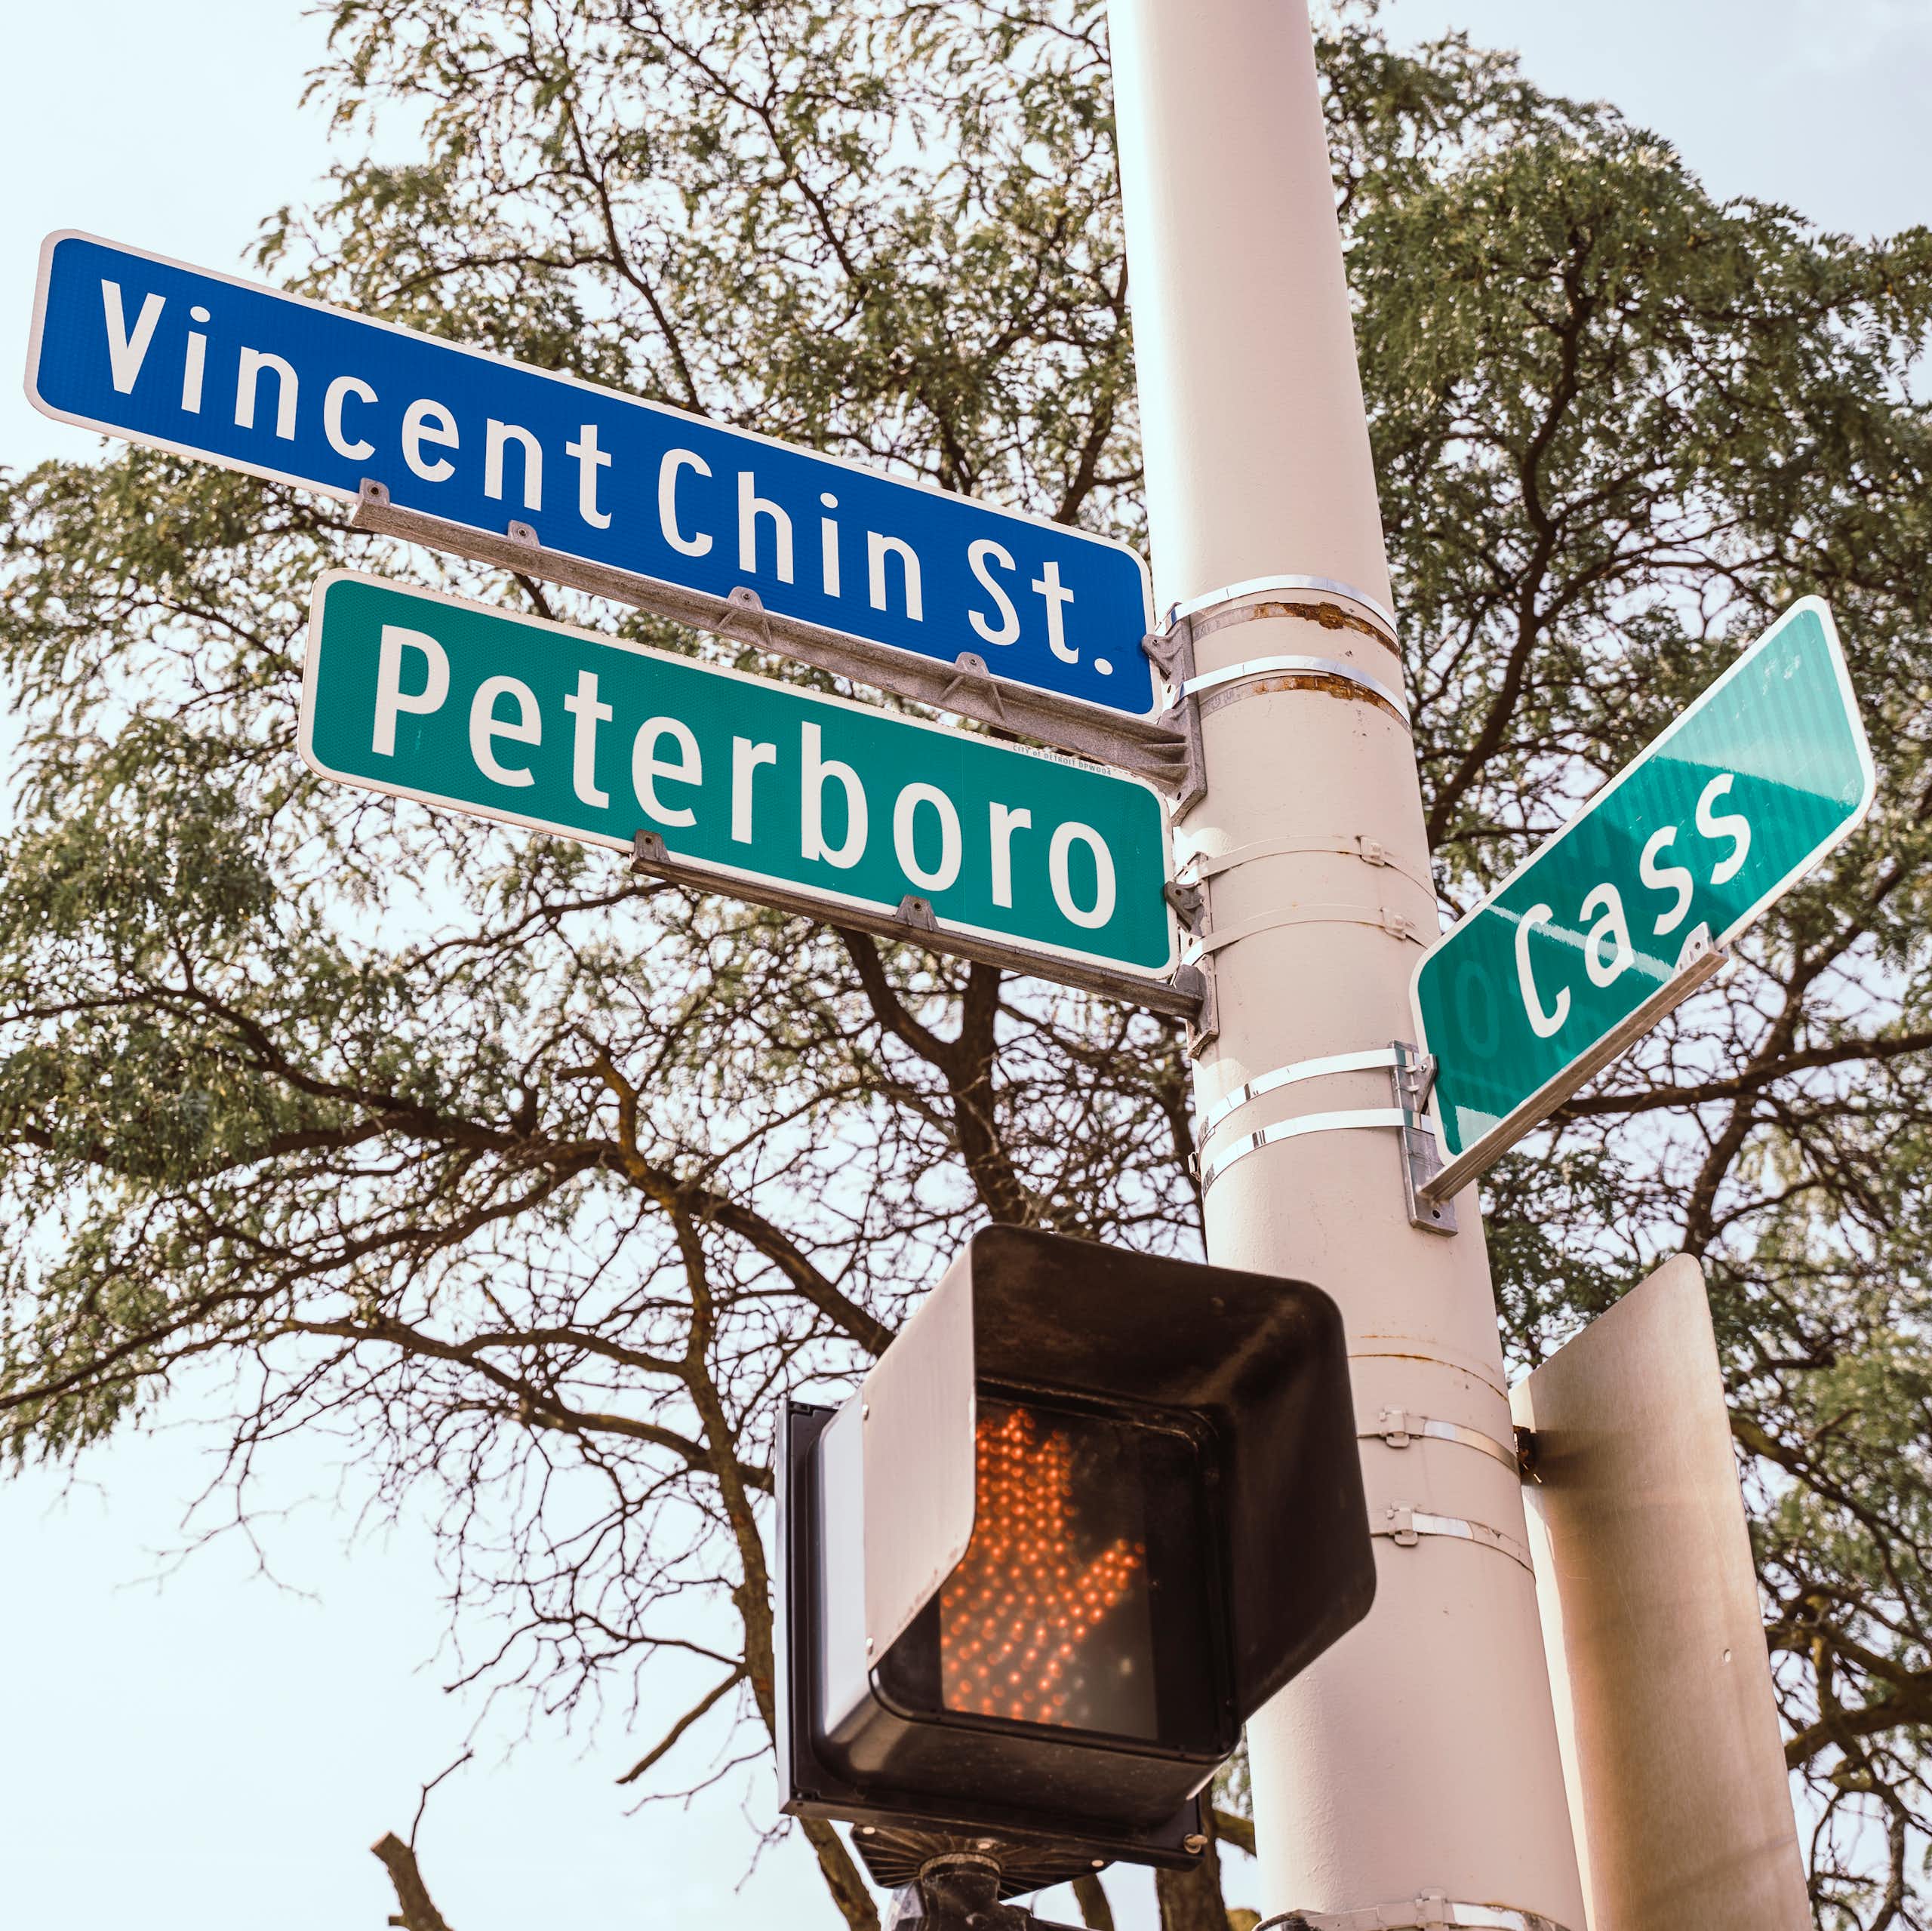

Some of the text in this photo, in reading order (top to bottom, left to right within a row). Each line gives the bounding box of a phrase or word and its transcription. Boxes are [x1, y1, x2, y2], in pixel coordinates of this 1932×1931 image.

[100, 278, 1114, 676] Vincent Chin St.
[372, 624, 1116, 930] Peterboro
[1013, 745, 1030, 754] CITY
[1044, 753, 1075, 766] DETROIT
[1515, 773, 1751, 1038] Cass
